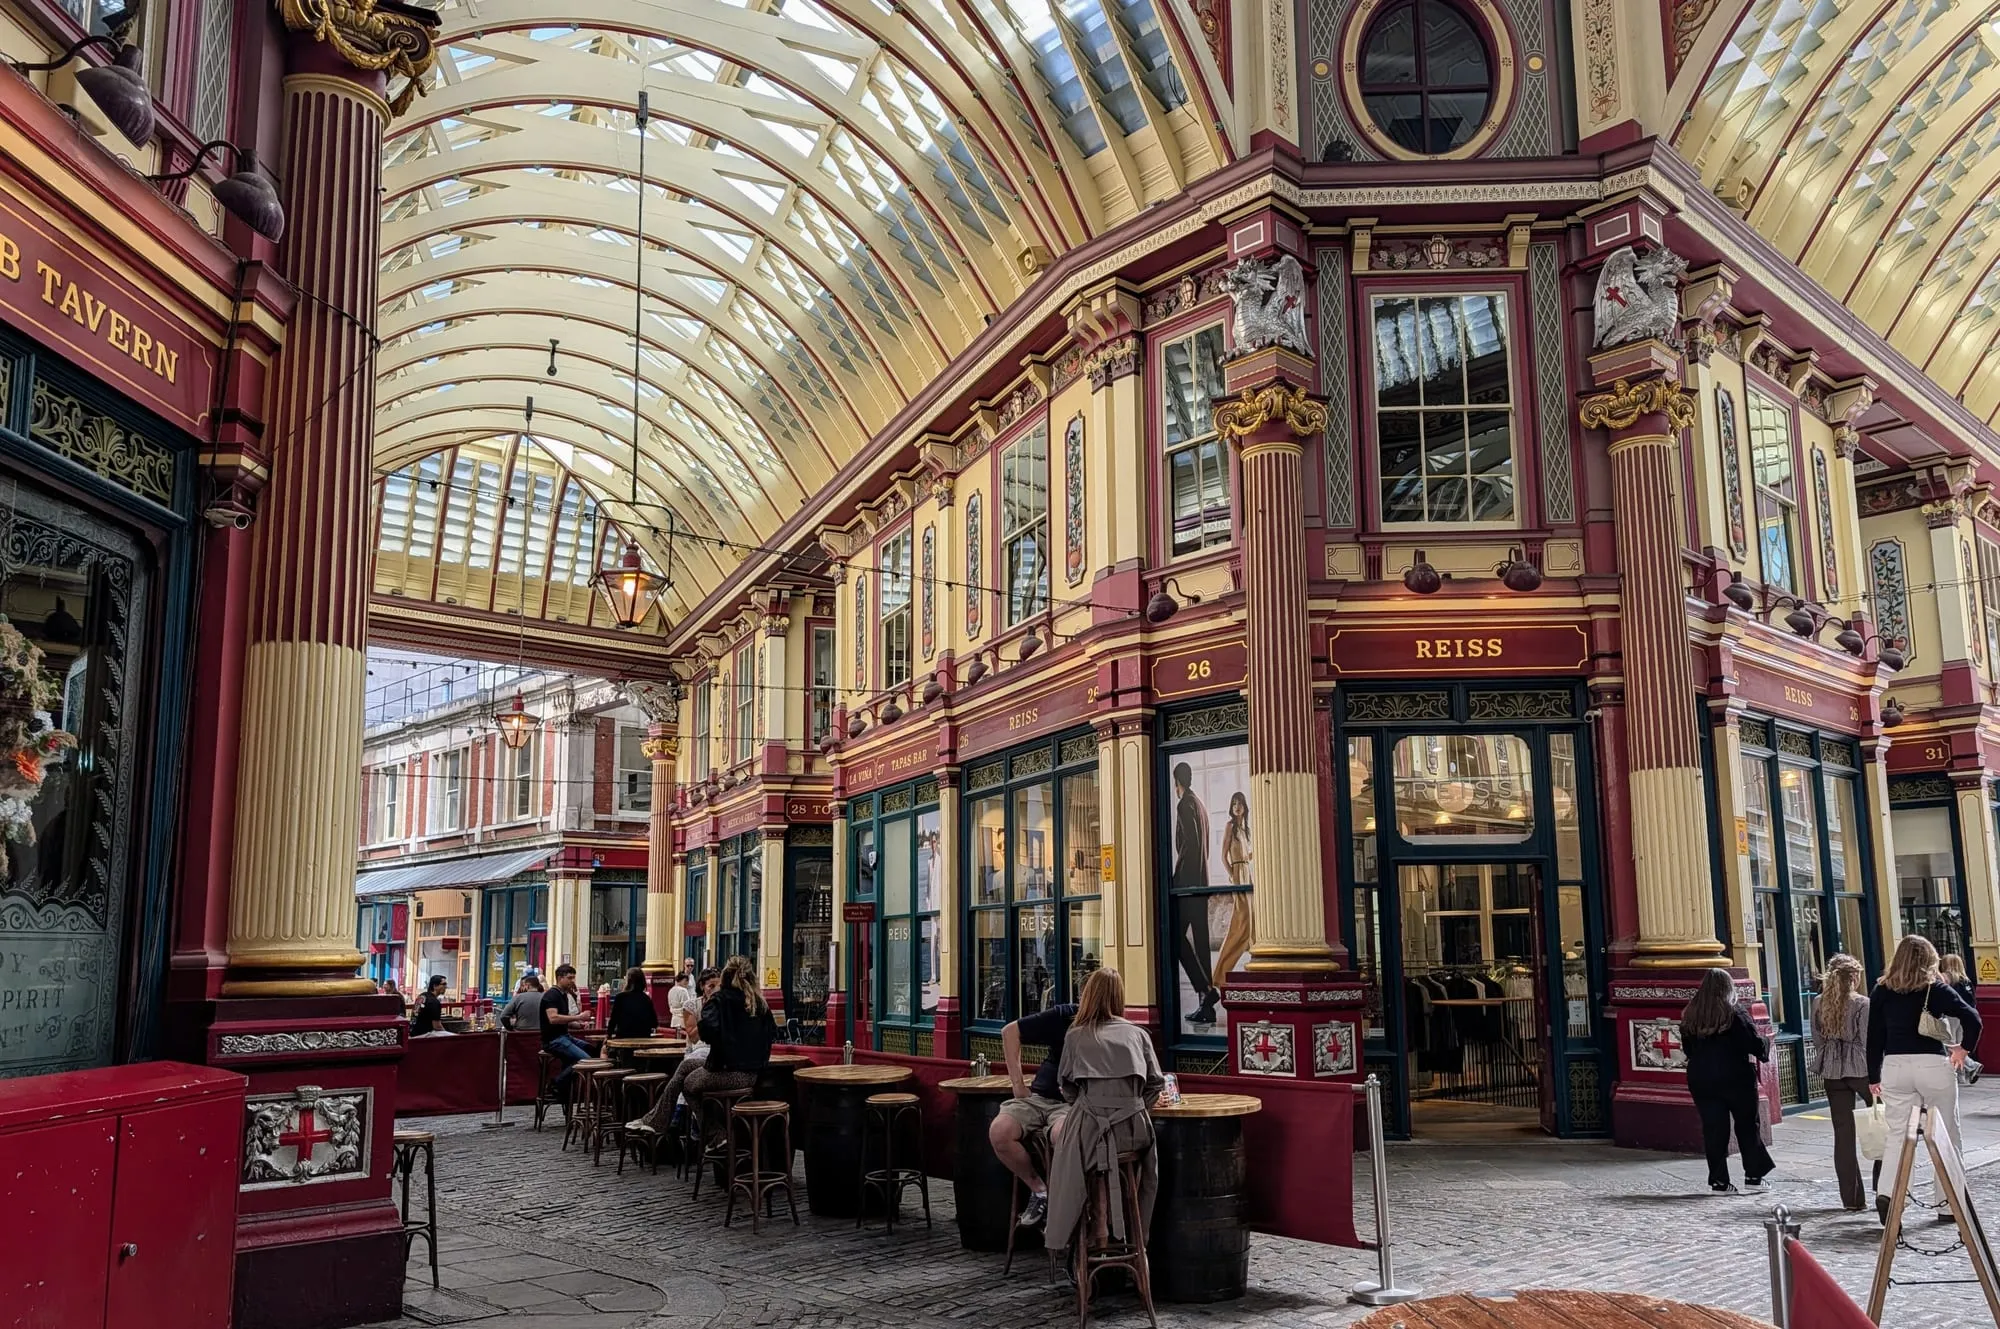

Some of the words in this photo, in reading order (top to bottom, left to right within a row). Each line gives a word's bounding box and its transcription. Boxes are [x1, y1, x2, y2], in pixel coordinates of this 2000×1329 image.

[37, 259, 179, 384] TAVERN
[1415, 638, 1503, 659] REISS
[1187, 659, 1211, 680] 26
[1784, 685, 1813, 707] REISS
[1849, 706, 1859, 721] 26
[959, 734, 969, 748] 26
[1009, 708, 1038, 731] REISS
[877, 763, 885, 776] 27
[891, 754, 912, 771] TAPAS
[913, 749, 928, 765] BAR
[1925, 747, 1944, 760] 31
[849, 774, 857, 786] LA
[858, 766, 873, 782] VIÑA
[1412, 780, 1513, 800] REISS
[791, 804, 807, 815] 28
[813, 805, 832, 815] TO
[1793, 907, 1818, 923] EISS
